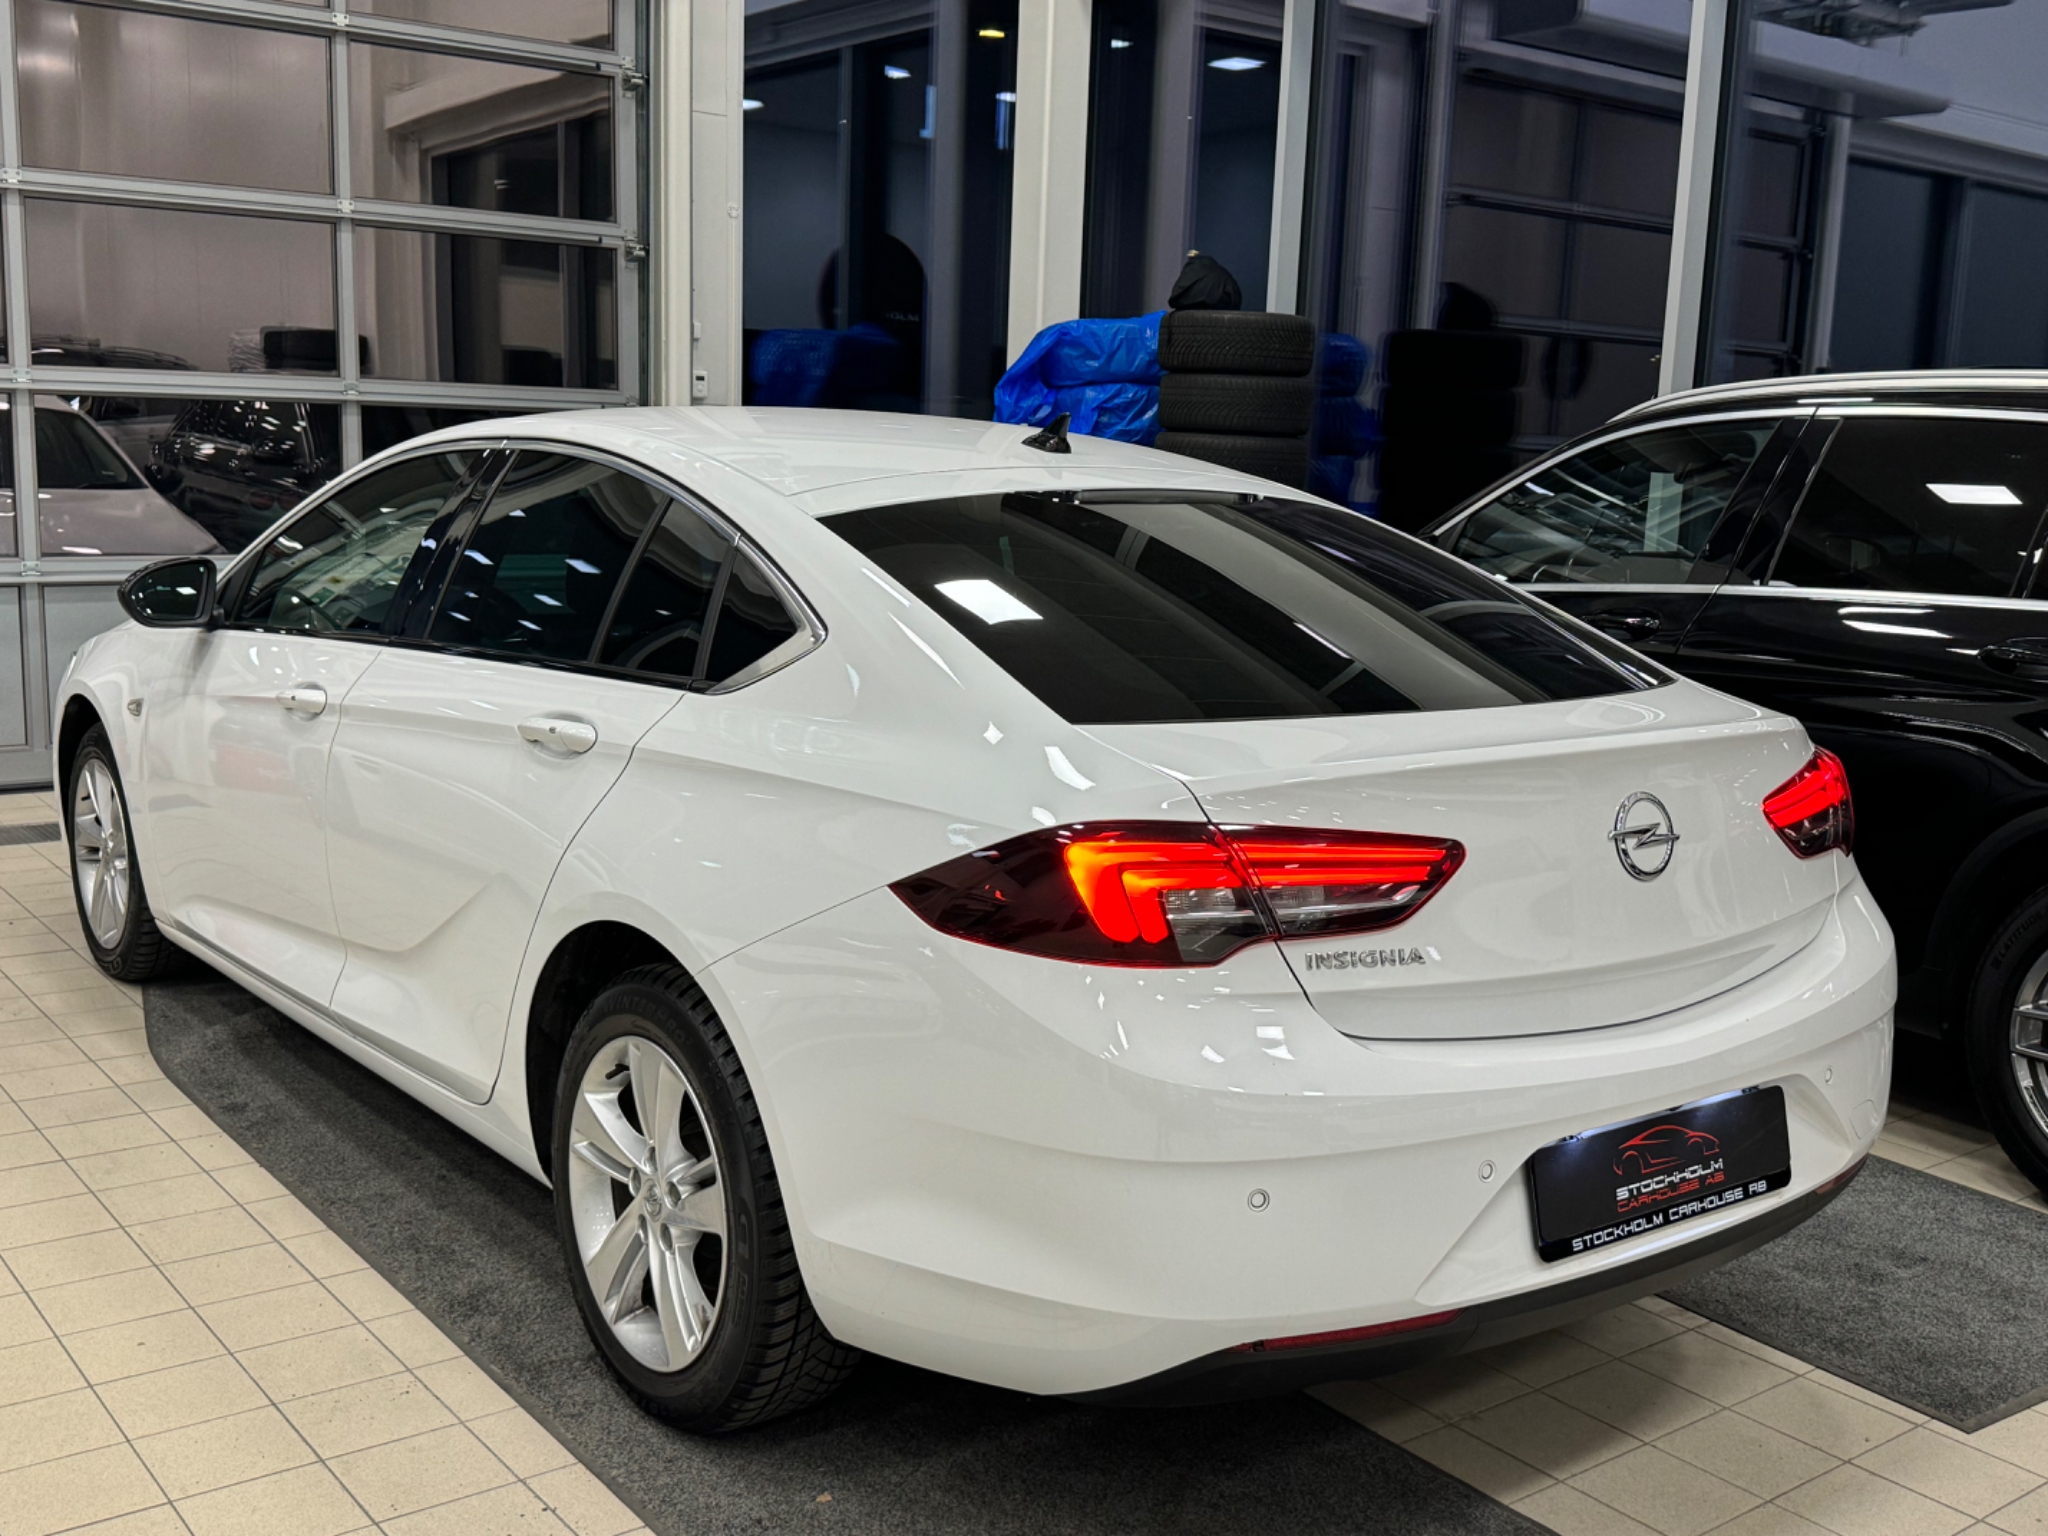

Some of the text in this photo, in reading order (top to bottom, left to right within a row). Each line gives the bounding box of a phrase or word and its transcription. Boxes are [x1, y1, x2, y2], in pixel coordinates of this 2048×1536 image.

[1305, 948, 1426, 971] INSIGNIA
[1616, 1158, 1724, 1201] STOCKHOLM
[1617, 1171, 1725, 1213] CARHOUSE AB
[1572, 1180, 1767, 1251] STOCKHOLM CARHOUSE AB
